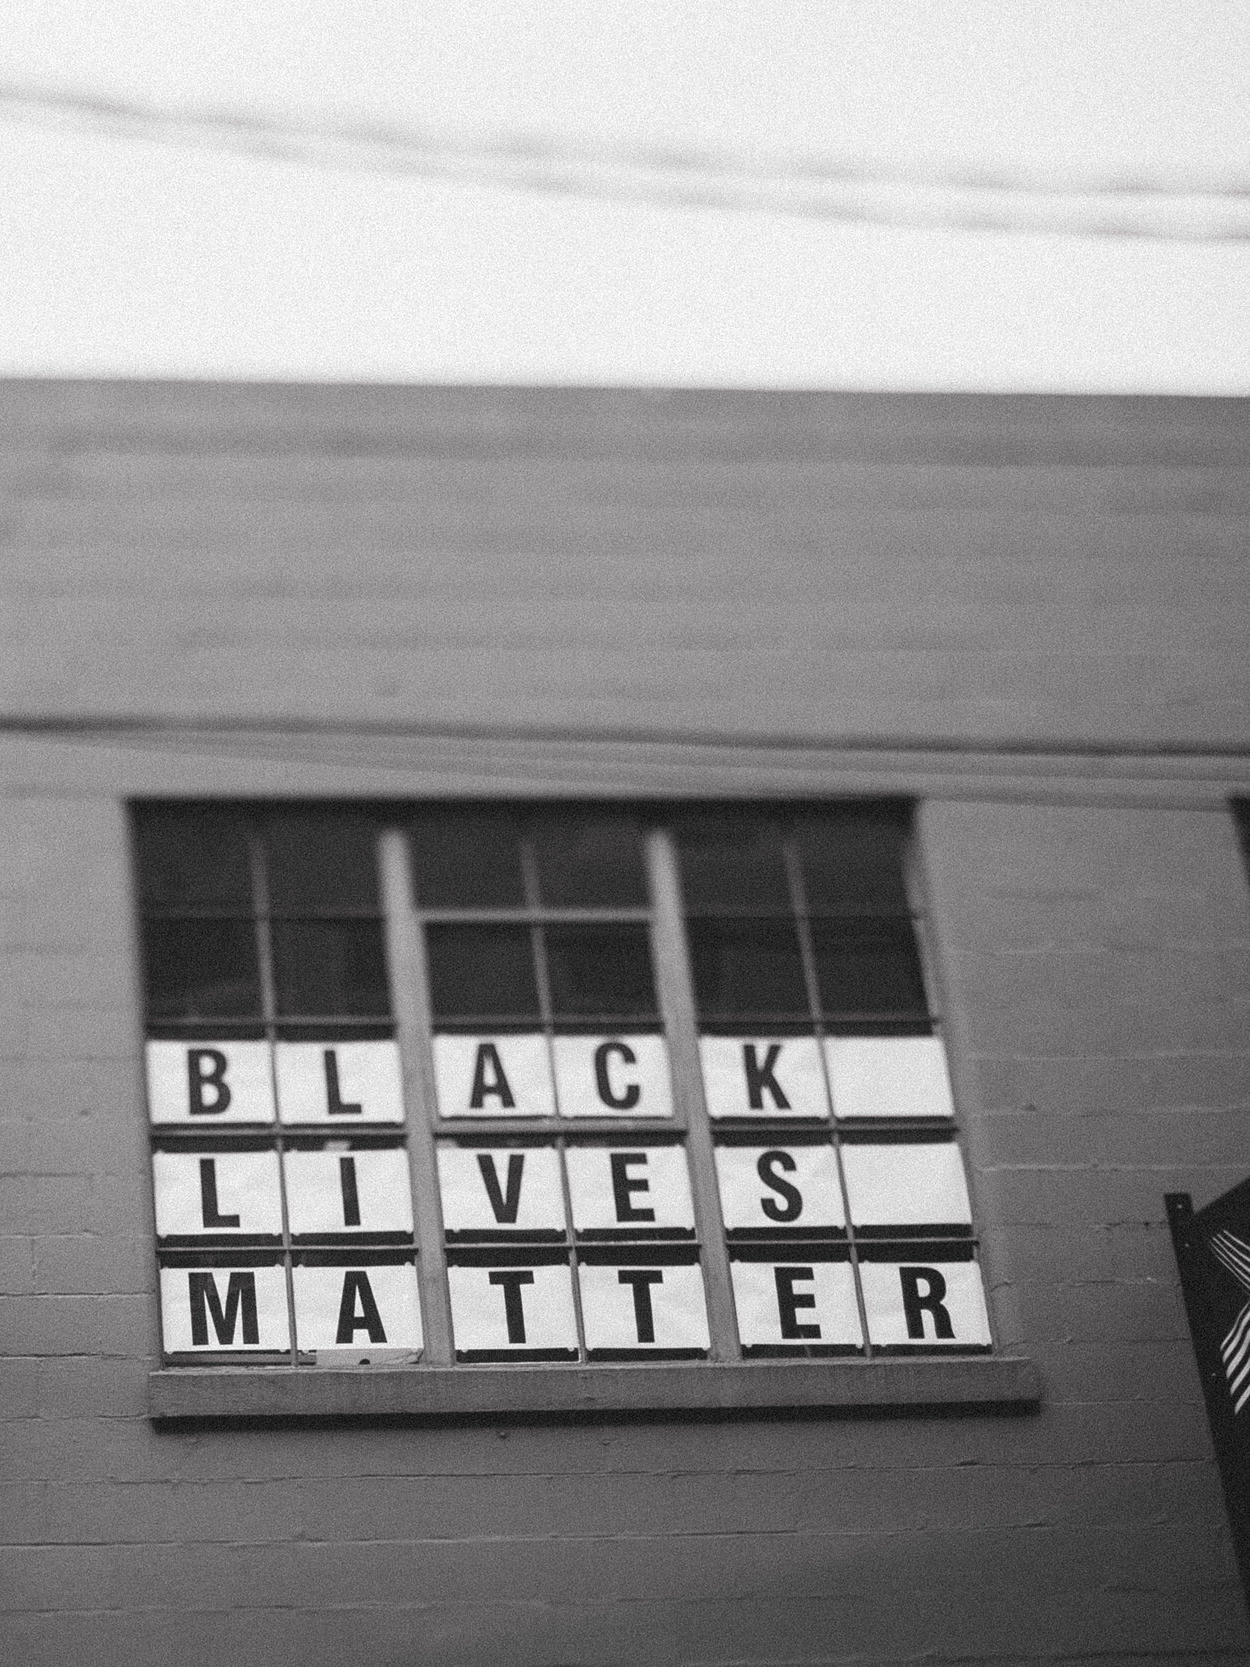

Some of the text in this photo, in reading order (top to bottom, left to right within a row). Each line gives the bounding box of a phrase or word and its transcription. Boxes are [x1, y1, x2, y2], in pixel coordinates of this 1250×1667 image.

[186, 1041, 793, 1116] BLACK
[199, 1149, 804, 1229] LIVES
[188, 1265, 957, 1346] MATTER
